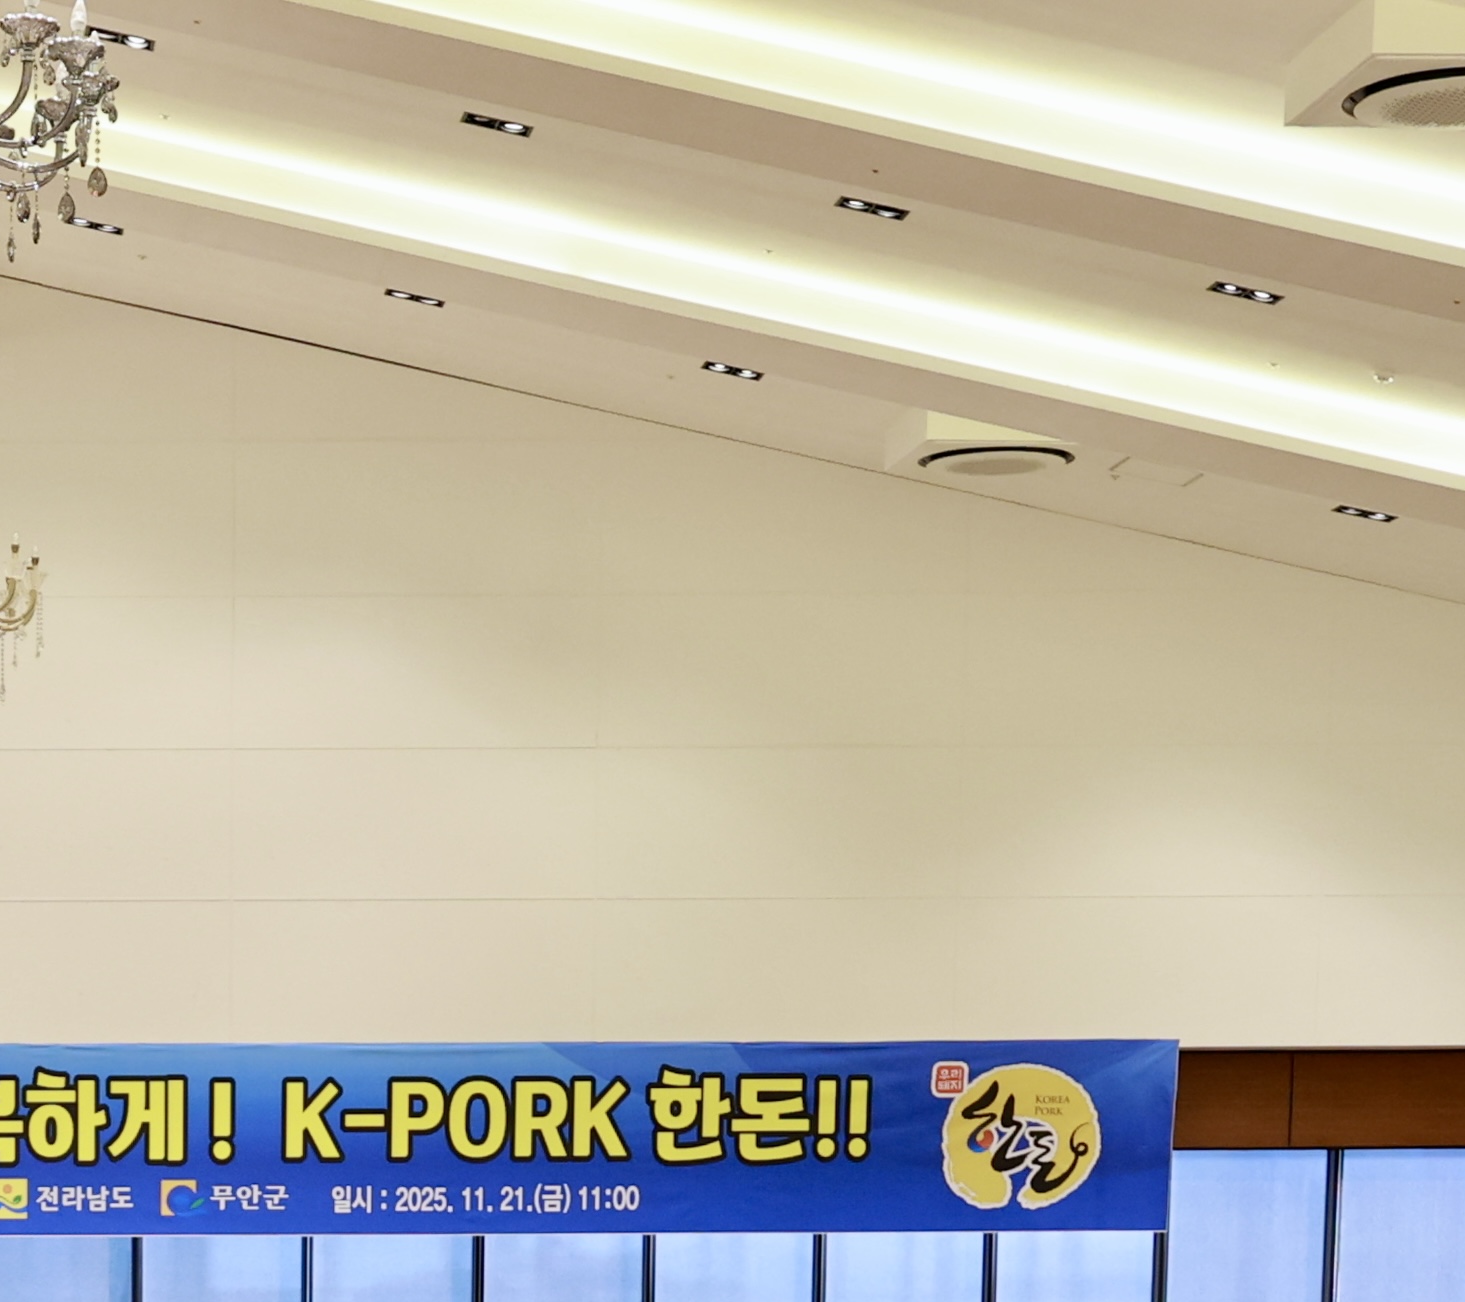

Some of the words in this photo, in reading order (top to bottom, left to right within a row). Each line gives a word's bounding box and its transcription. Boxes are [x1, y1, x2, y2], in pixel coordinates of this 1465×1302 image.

[1034, 1107, 1063, 1116] PORK
[1035, 1095, 1071, 1105] KOREA
[285, 1080, 627, 1158] K-PORK
[650, 1070, 868, 1161] 한돈!!
[35, 1185, 134, 1212] 전라남도
[209, 1184, 289, 1211] 무안군
[331, 1185, 372, 1214] 일시
[394, 1186, 454, 1213] 2025.
[461, 1186, 493, 1213] 11.
[499, 1183, 571, 1214] 21.(금)
[578, 1185, 640, 1211] 11:00
